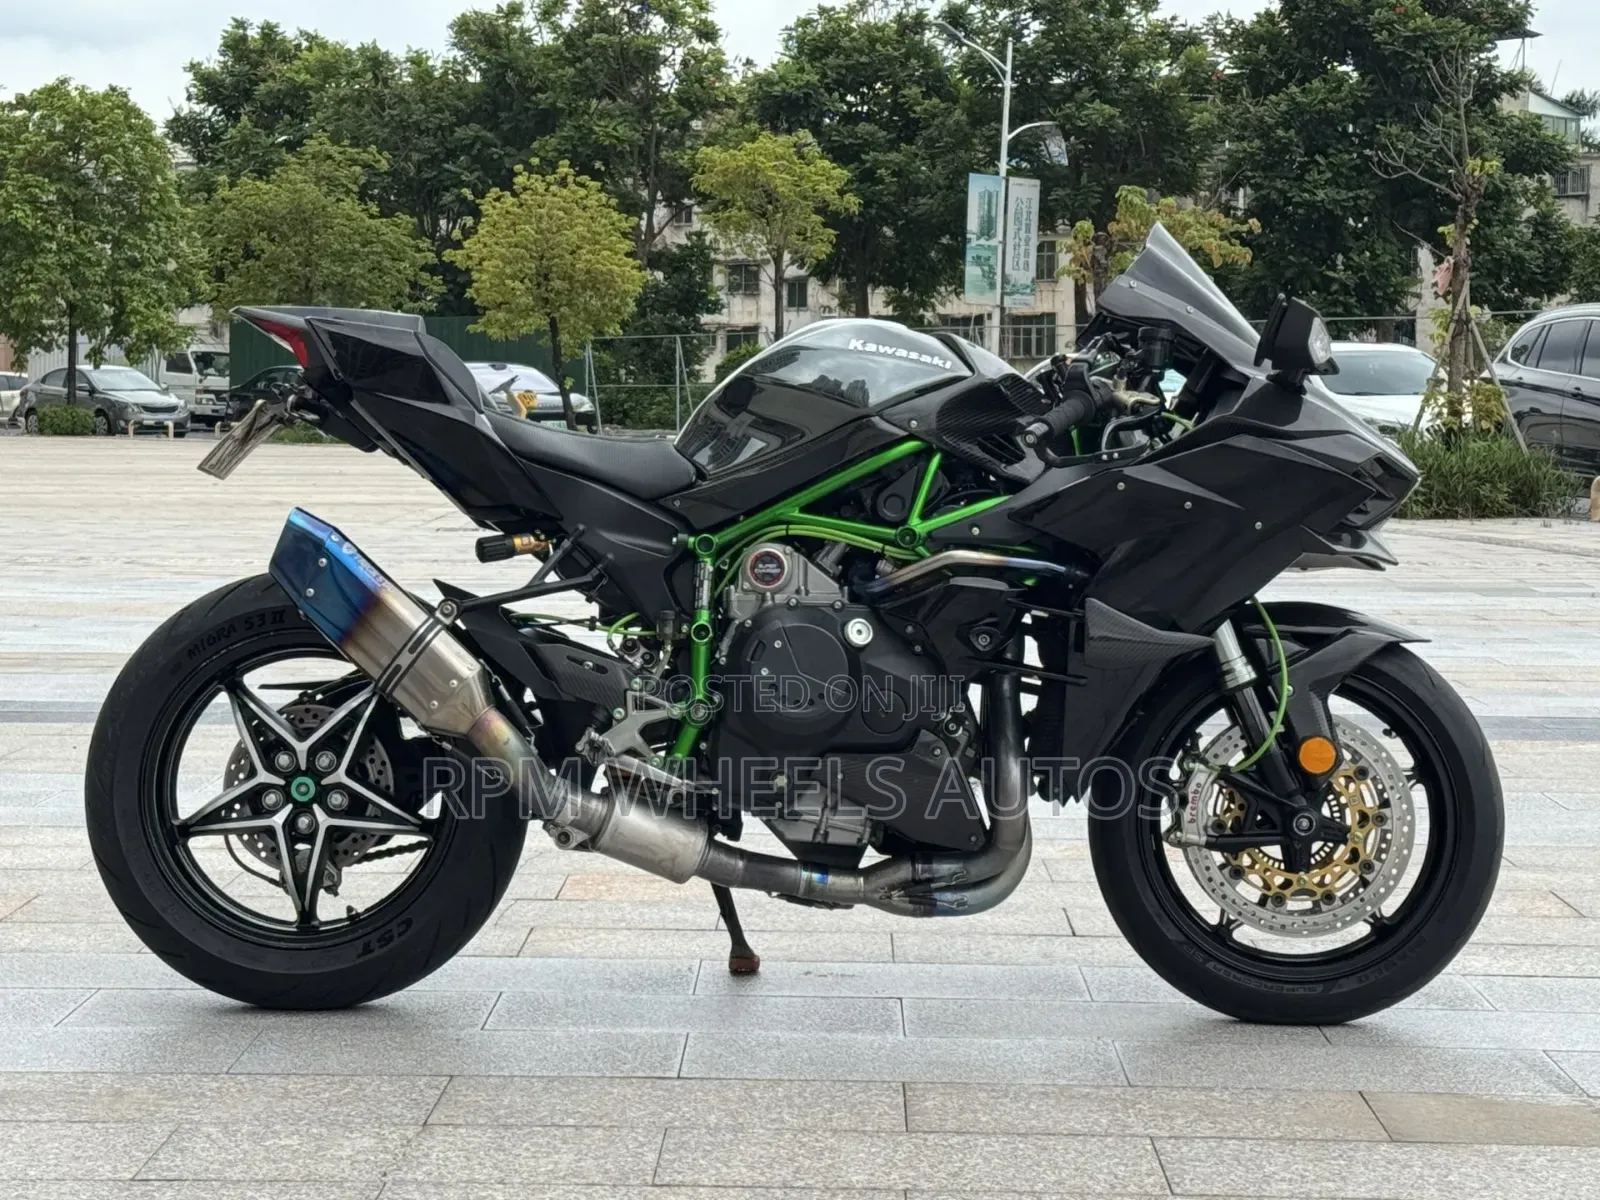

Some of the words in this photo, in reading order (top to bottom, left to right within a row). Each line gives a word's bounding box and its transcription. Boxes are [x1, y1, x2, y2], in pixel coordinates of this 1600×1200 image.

[1011, 196, 1024, 272] 公园式社区
[848, 338, 953, 370] Kawasaki
[243, 612, 267, 632] S3
[1187, 782, 1202, 824] brembo
[356, 917, 414, 960] CST
[1211, 963, 1319, 994] SUPERCORSA
